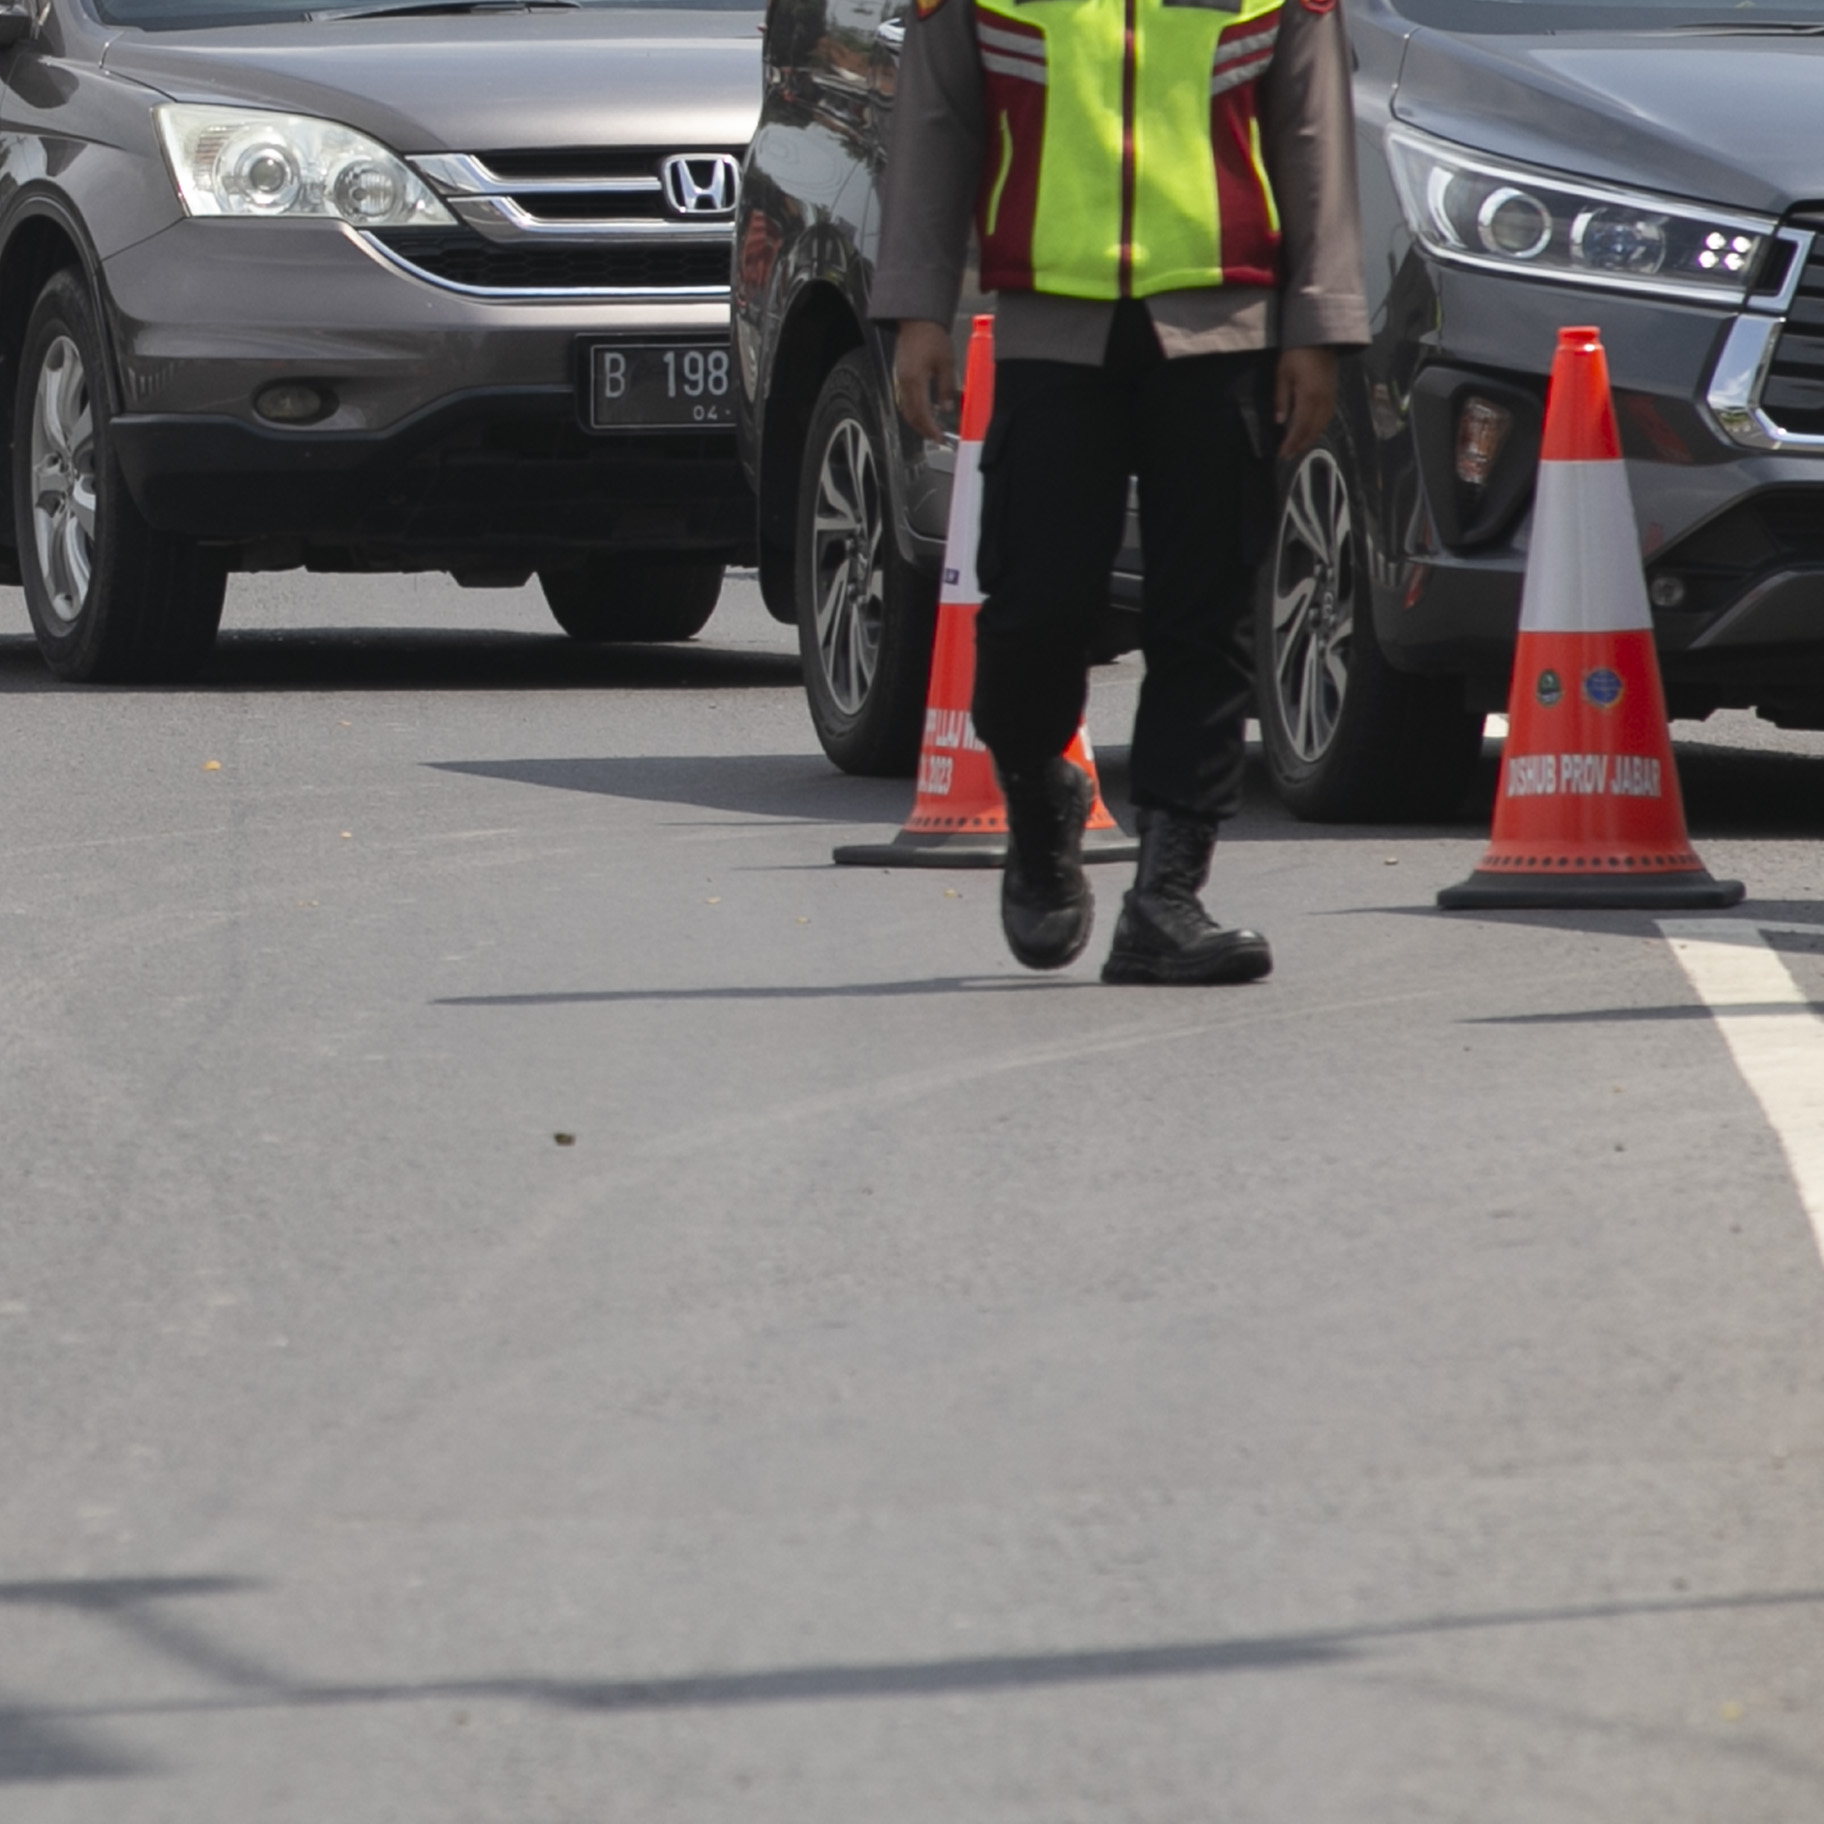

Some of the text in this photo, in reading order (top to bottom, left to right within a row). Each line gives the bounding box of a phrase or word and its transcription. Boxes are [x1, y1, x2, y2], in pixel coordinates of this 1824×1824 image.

[604, 352, 626, 398] B
[1507, 754, 1661, 799] DISHUB PROV JABAR
